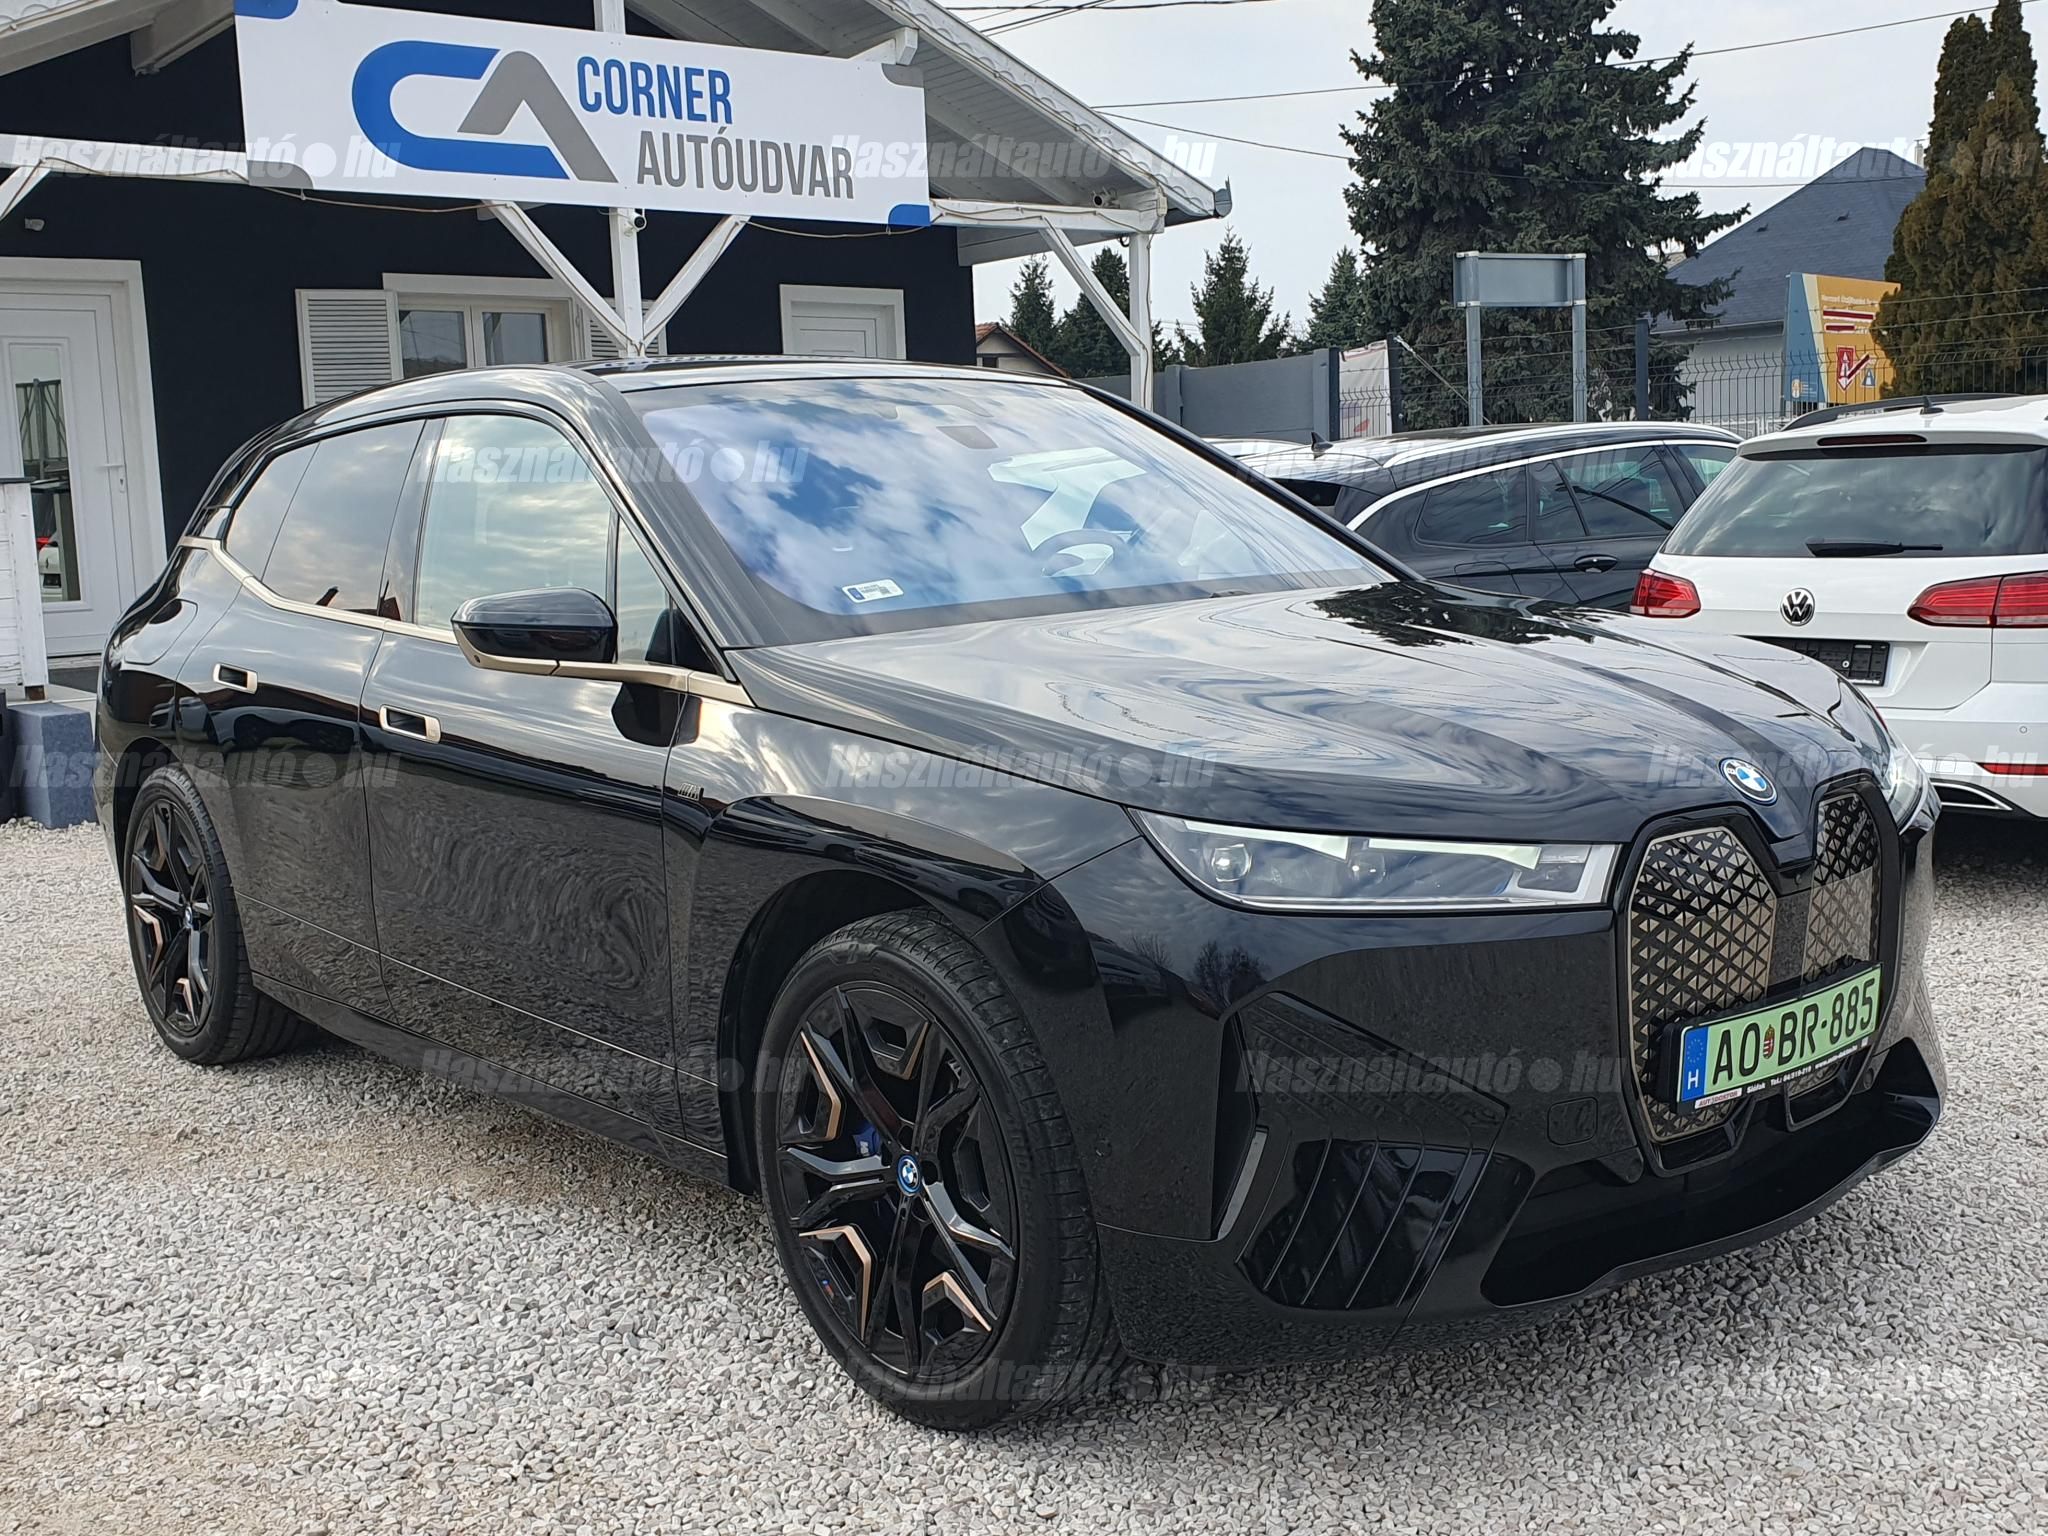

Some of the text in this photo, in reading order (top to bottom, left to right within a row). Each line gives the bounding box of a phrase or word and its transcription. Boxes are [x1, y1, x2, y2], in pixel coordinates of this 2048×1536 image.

[577, 56, 733, 125] CORNER
[636, 126, 854, 200] AUTÓUDVAR
[1687, 1069, 1699, 1090] H
